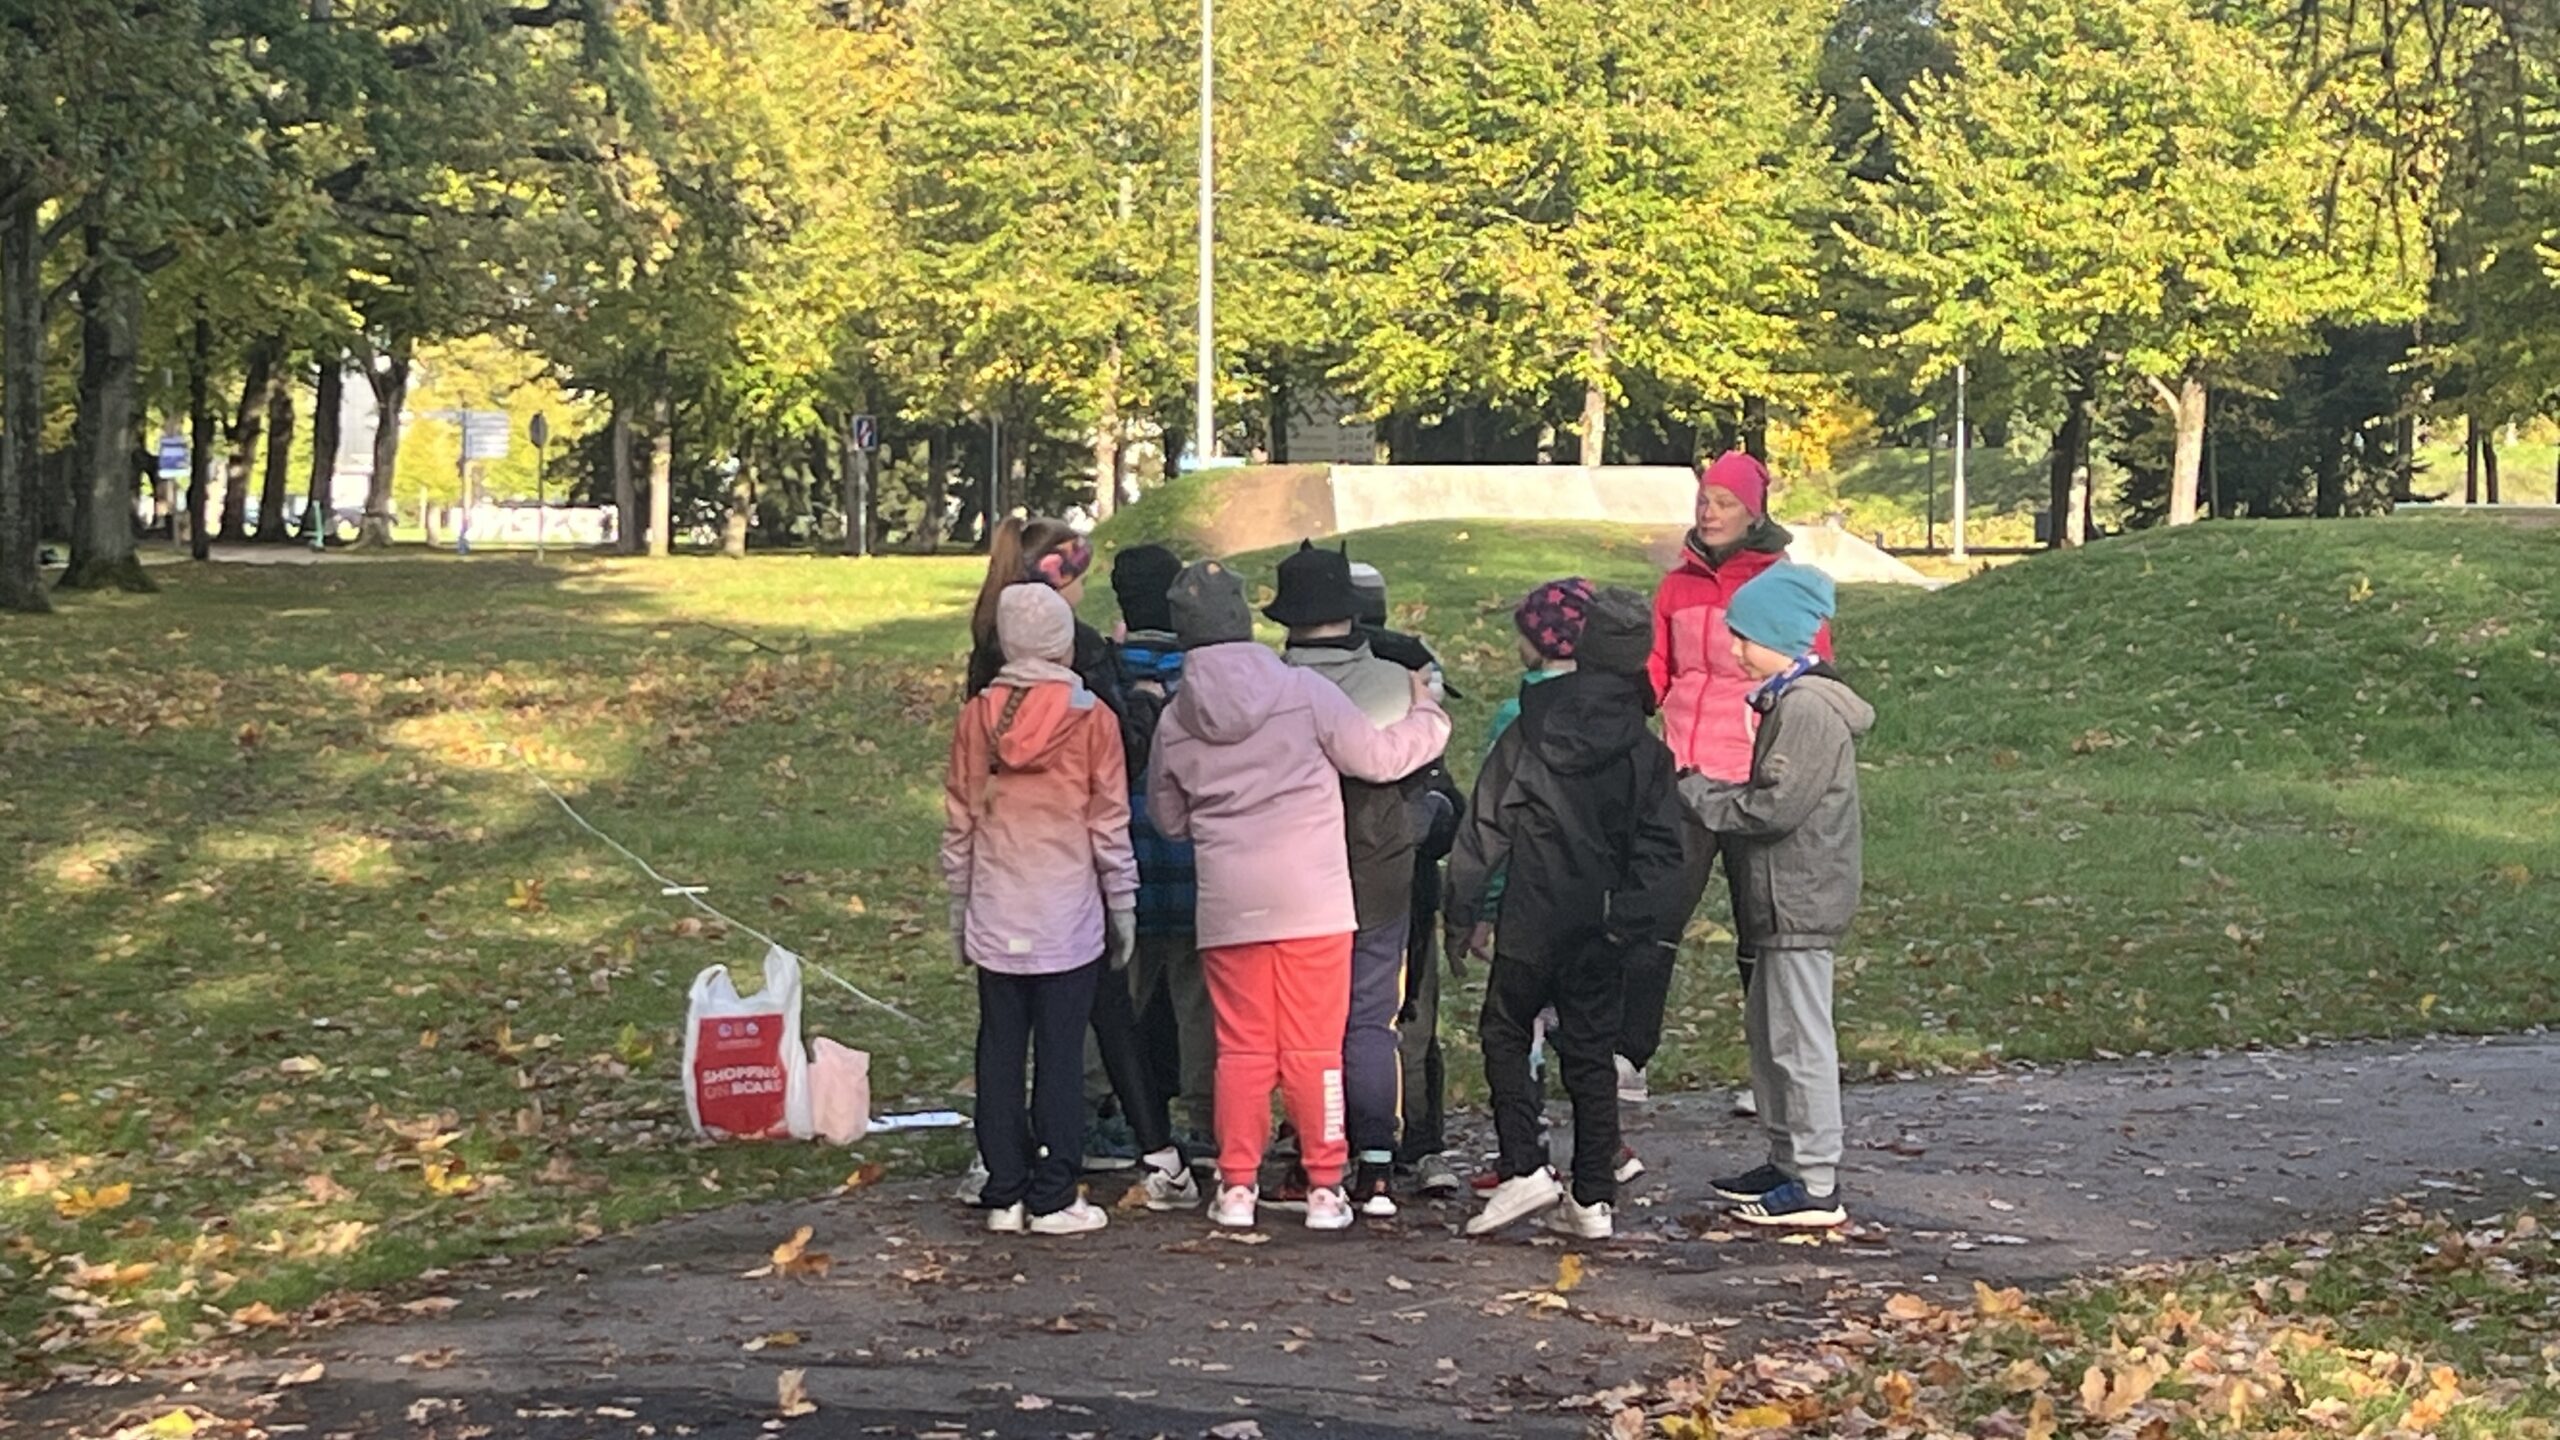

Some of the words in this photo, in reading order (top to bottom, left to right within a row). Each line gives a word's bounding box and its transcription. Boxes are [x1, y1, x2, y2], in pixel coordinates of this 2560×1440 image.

[702, 1066, 780, 1084] SHOPPING
[704, 1083, 730, 1099] ON
[1323, 1069, 1344, 1142] PUMA
